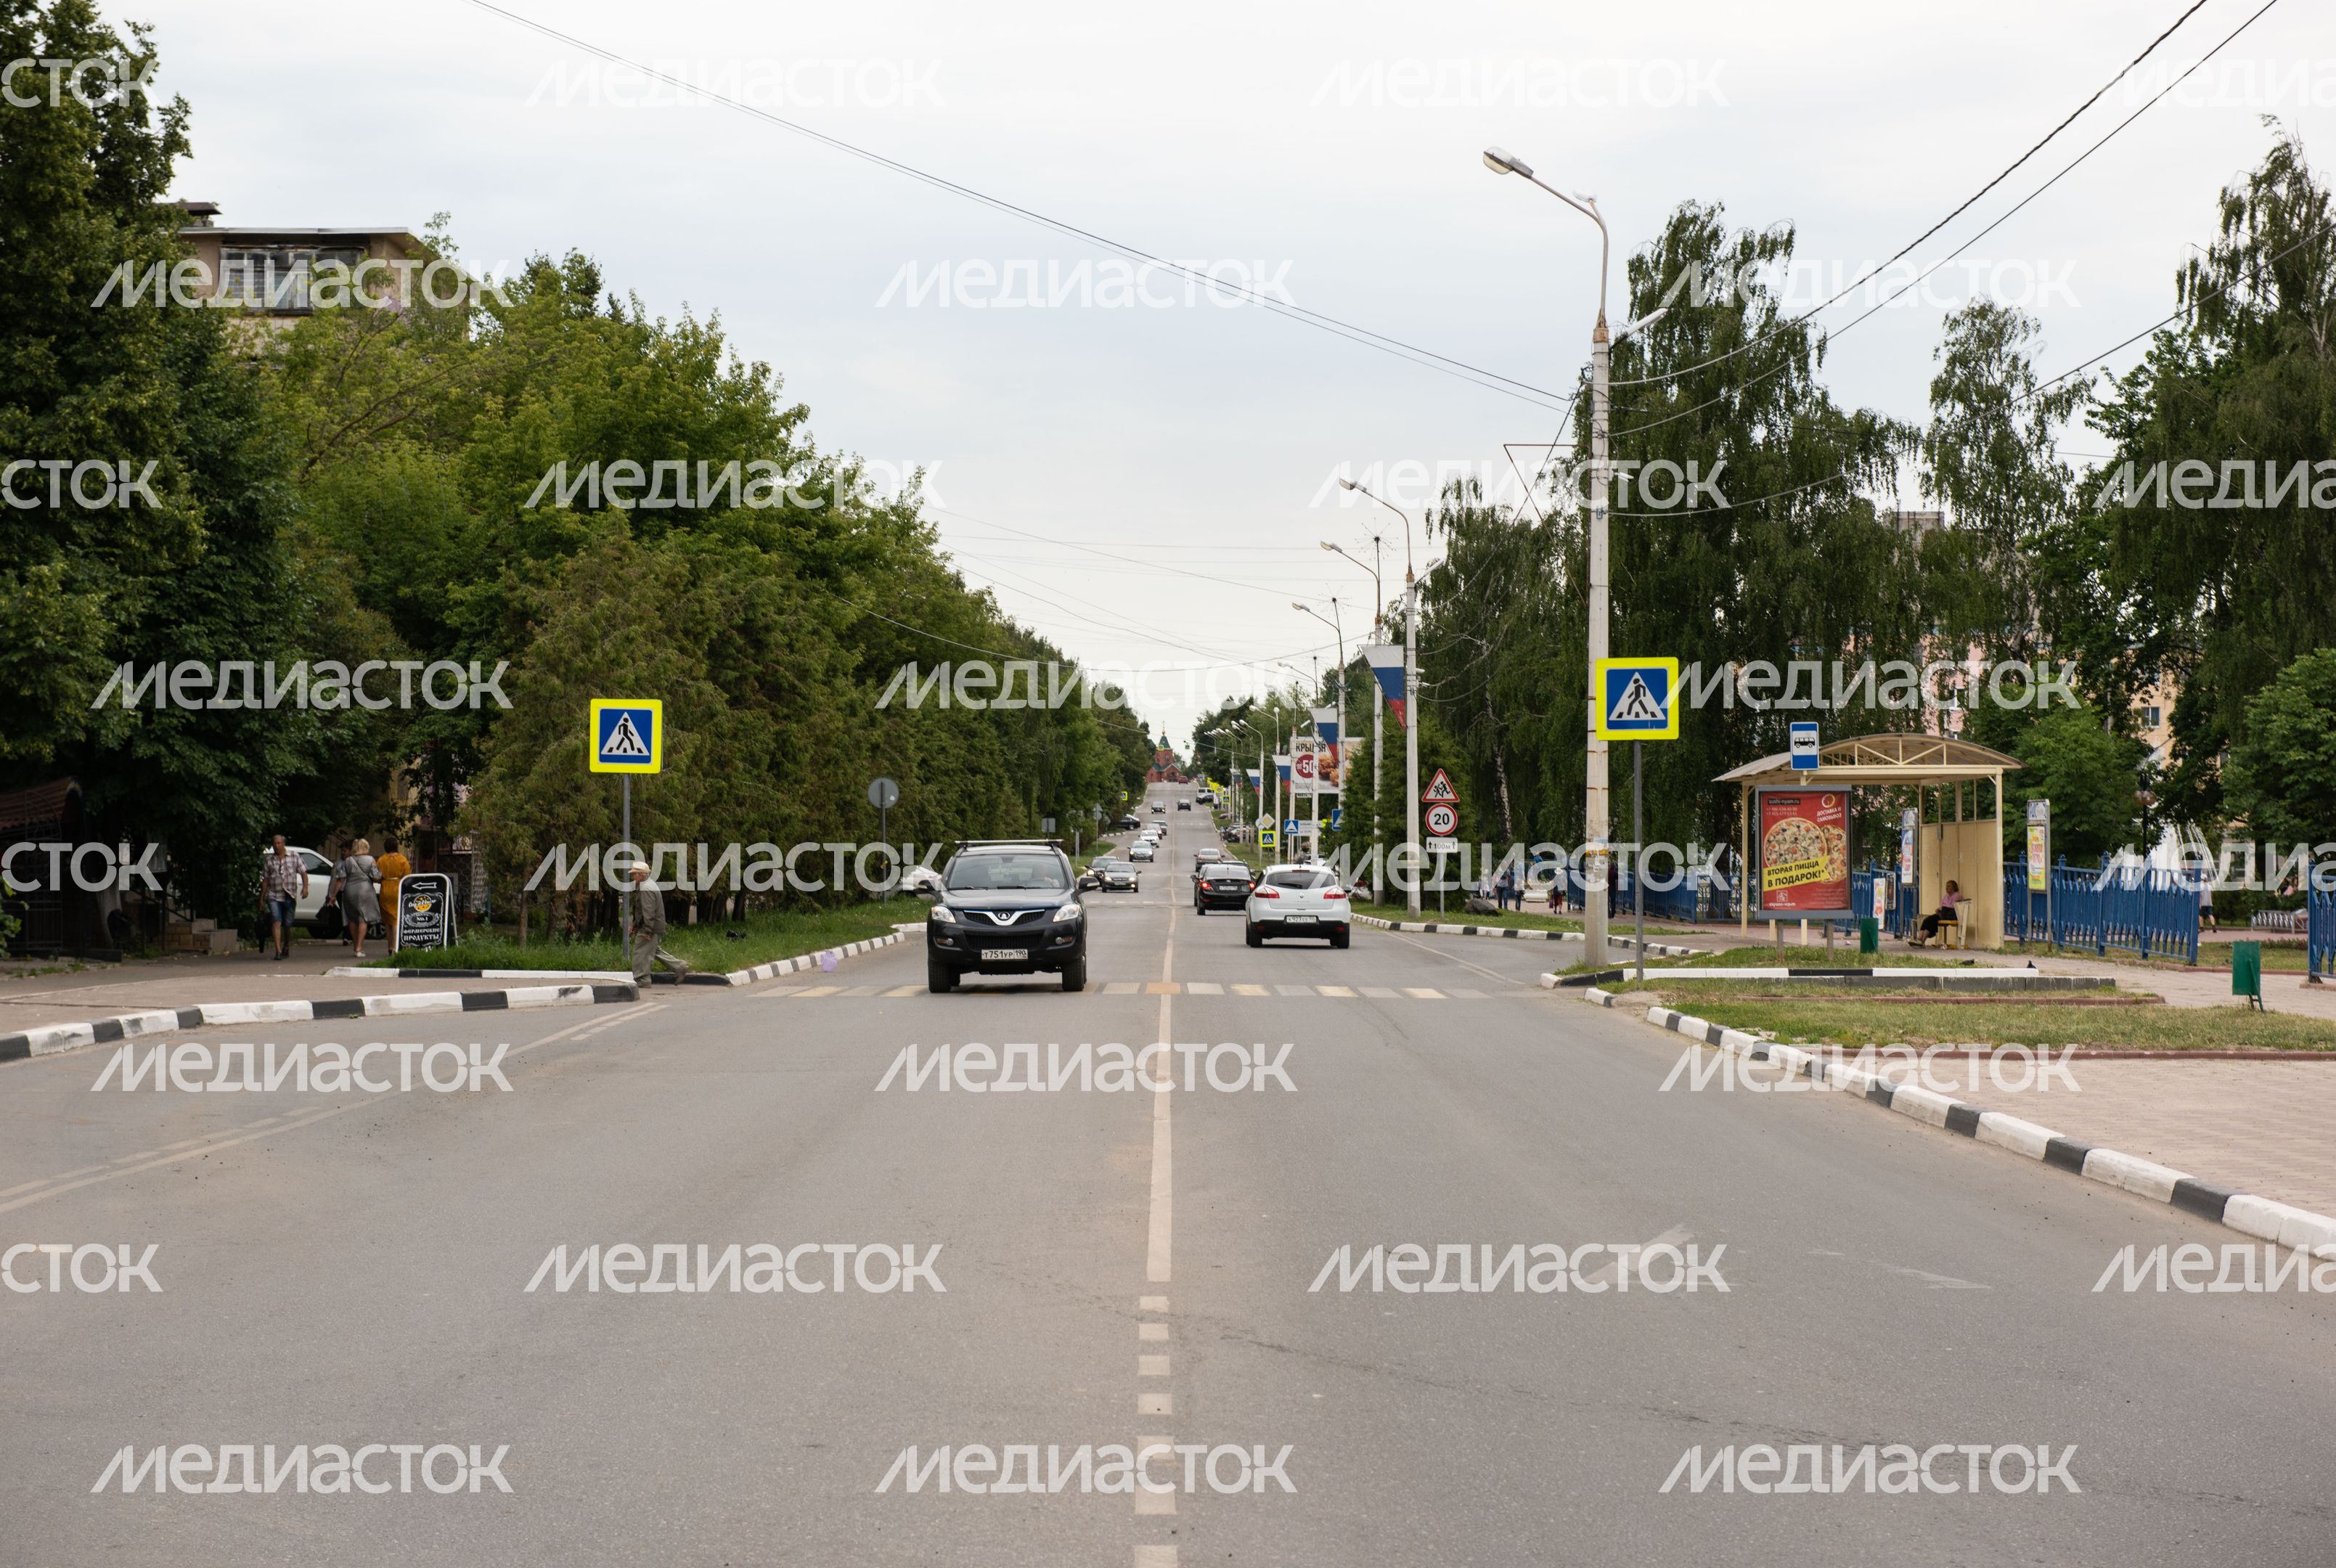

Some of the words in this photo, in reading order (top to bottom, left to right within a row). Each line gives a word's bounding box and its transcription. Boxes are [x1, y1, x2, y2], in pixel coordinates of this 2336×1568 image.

[1817, 807, 1837, 817] ДОСТАВКА
[1817, 813, 1842, 822] САМОВЫВОЗ
[1434, 813, 1450, 825] 20
[1767, 866, 1793, 876] ВТОРАЯ
[1794, 860, 1820, 871] ПИЦЦА
